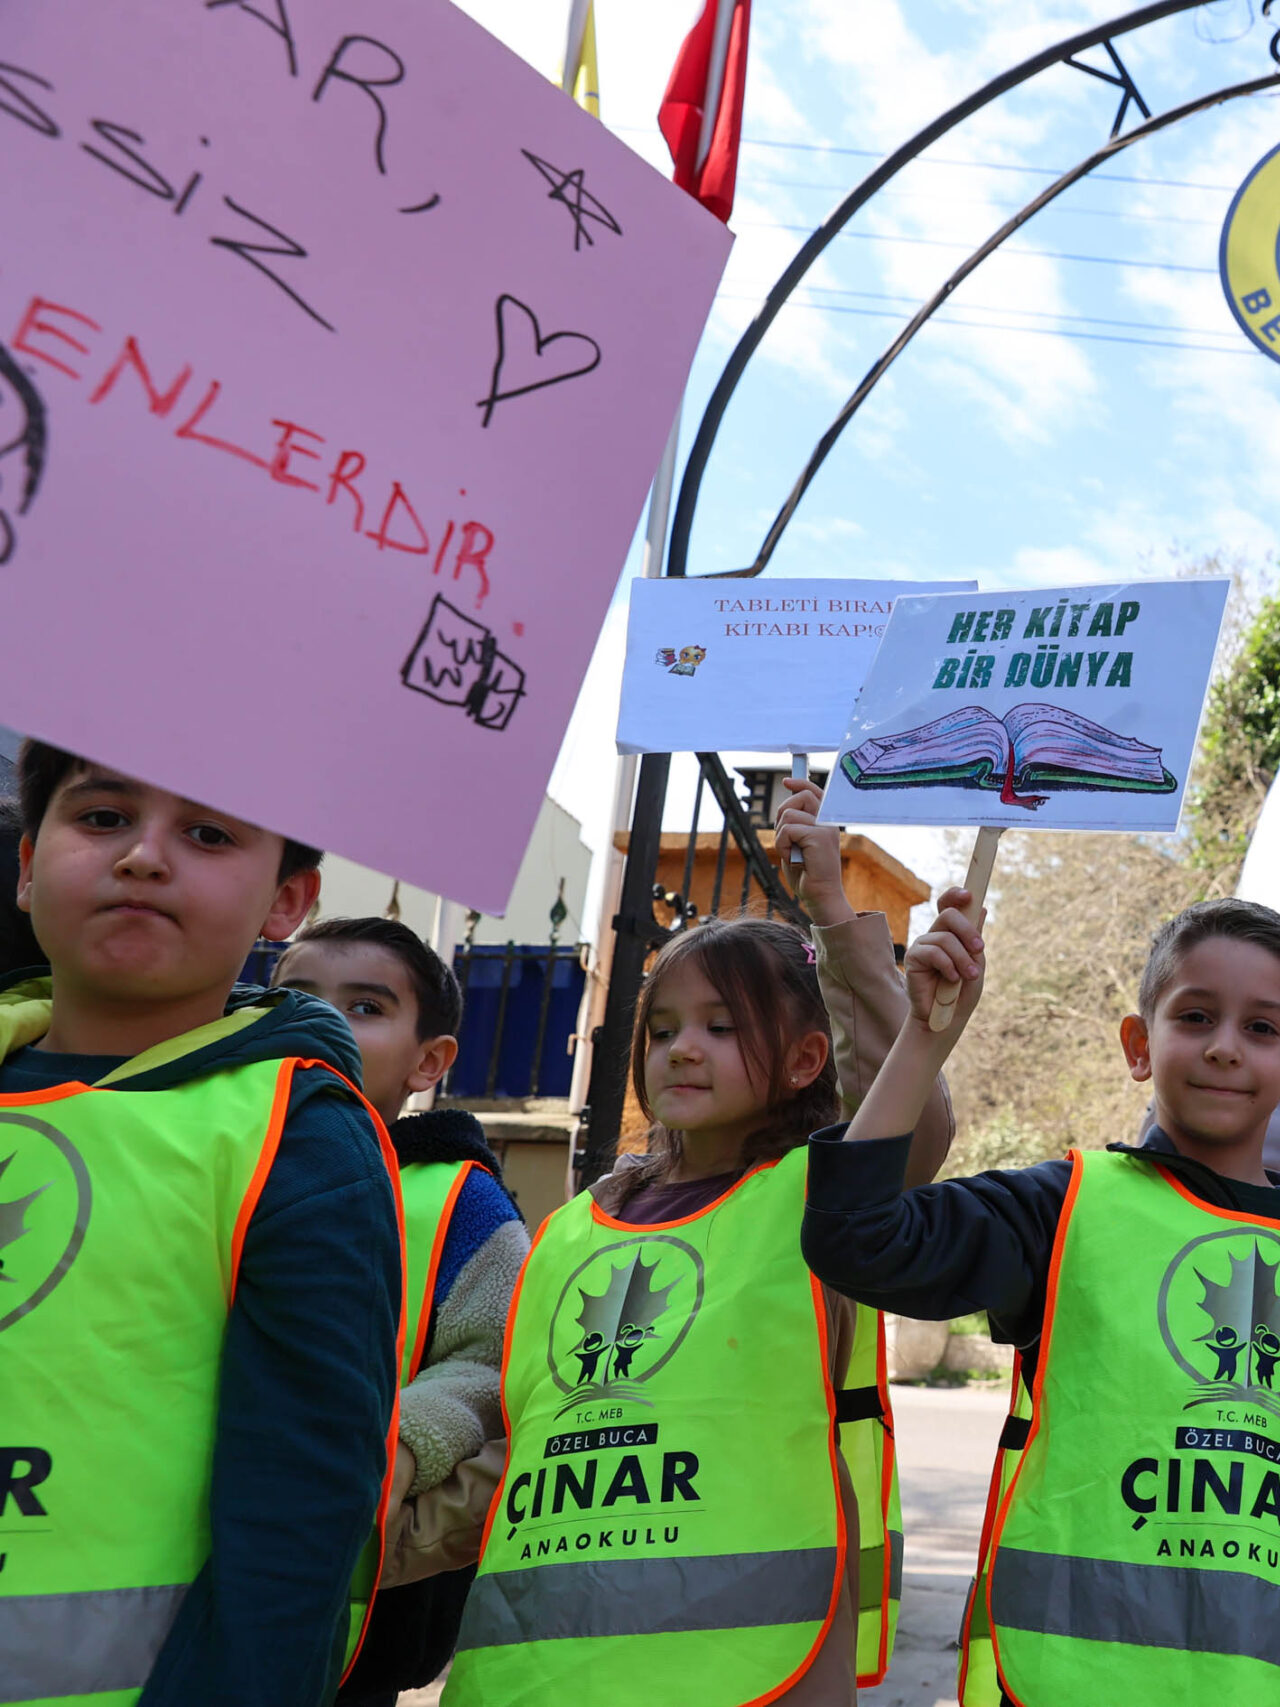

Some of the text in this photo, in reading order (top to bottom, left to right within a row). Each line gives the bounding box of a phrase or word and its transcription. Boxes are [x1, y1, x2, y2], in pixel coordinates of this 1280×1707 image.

[714, 596, 818, 613] TABLETİ
[725, 619, 809, 637] KİTABI
[945, 598, 1140, 644] HER KİTAP
[932, 644, 1135, 690] BİR DÜNYA
[576, 1407, 623, 1425] T.C. MEB
[1216, 1410, 1268, 1429] T.C. MEB
[550, 1429, 648, 1454] ÖZEL BUCA
[1184, 1428, 1234, 1449] ÖZEL
[506, 1450, 702, 1541] ÇINAR
[520, 1526, 679, 1561] ANAOKULU
